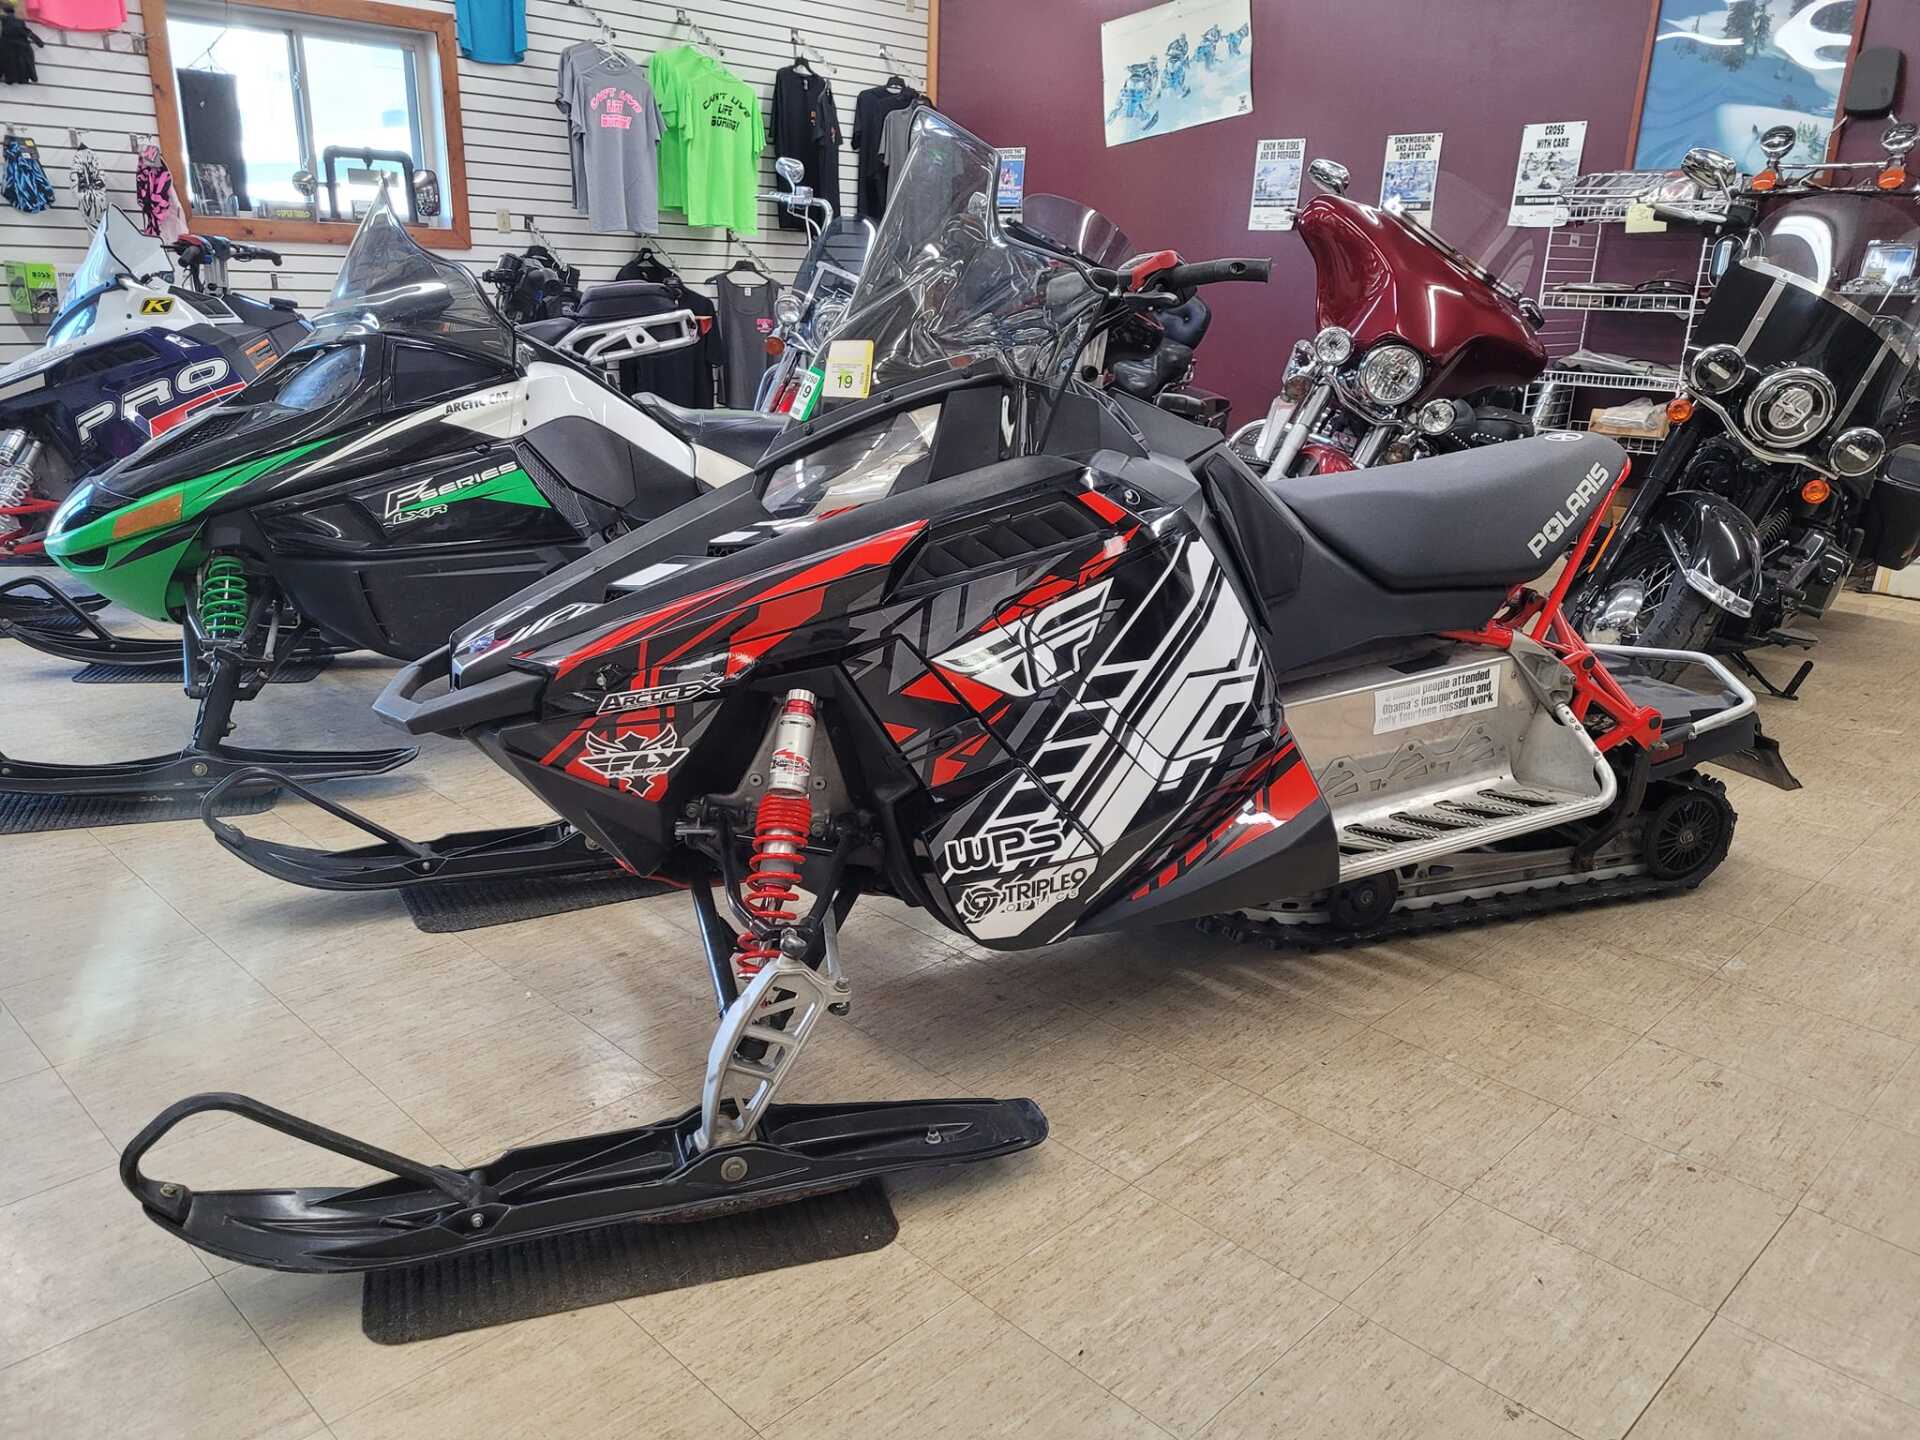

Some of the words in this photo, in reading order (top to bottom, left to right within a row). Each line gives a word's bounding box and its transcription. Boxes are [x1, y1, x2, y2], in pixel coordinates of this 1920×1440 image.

[718, 103, 733, 116] LIFE
[1395, 135, 1435, 145] SNOWMOBILING
[1545, 125, 1565, 136] CROSS
[1408, 143, 1432, 151] ALCOHOL
[1537, 139, 1552, 149] WITH
[1553, 138, 1569, 148] CARE
[837, 374, 853, 389] 19
[75, 357, 230, 446] PRO
[445, 397, 486, 415] ARCTIC
[489, 391, 509, 405] CAT
[393, 503, 448, 525] LXR
[1527, 461, 1610, 559] POLARIS
[1422, 680, 1450, 695] people
[1451, 668, 1491, 687] attended
[1421, 686, 1475, 707] inauguration
[1475, 680, 1492, 695] and
[1439, 697, 1469, 713] missed
[1470, 691, 1494, 706] work
[945, 818, 1066, 874] WPS
[1006, 891, 1078, 912] OPTICS
